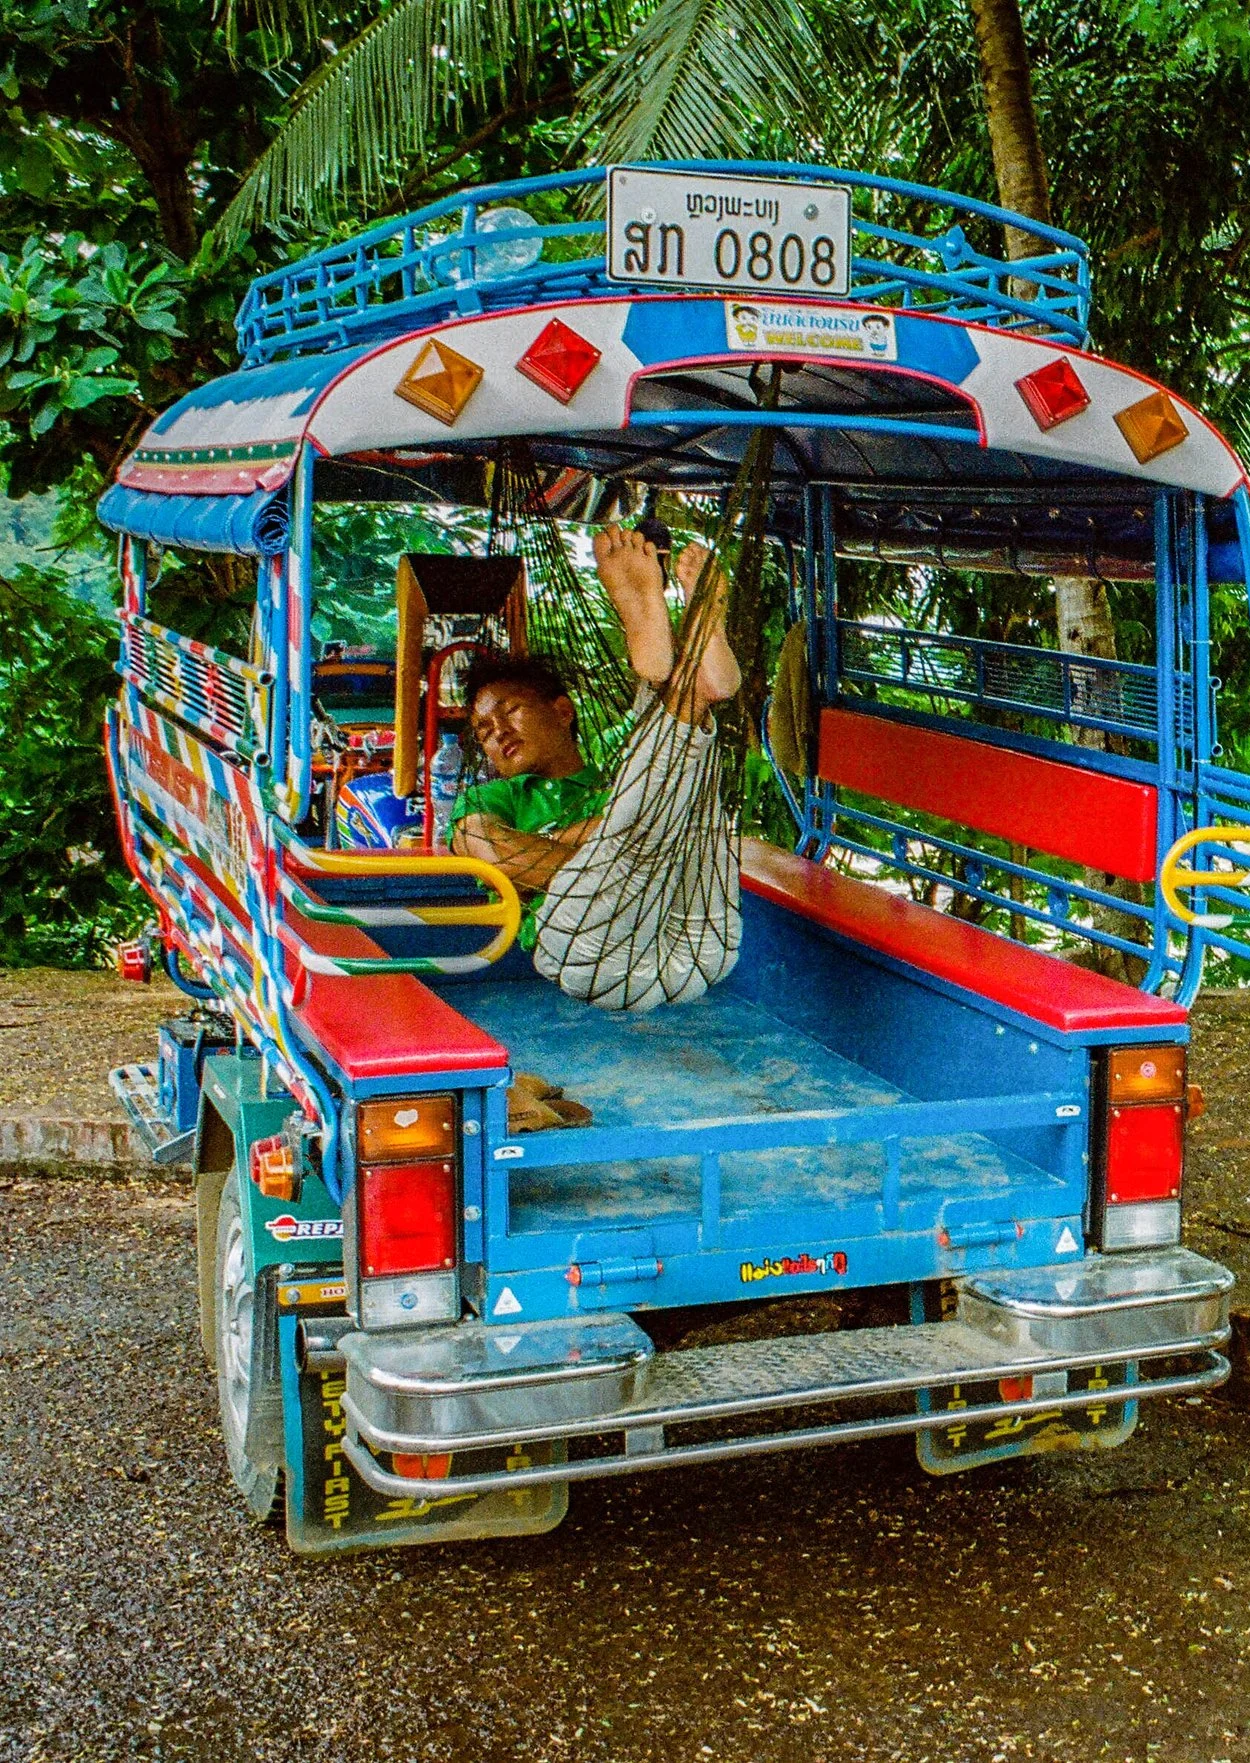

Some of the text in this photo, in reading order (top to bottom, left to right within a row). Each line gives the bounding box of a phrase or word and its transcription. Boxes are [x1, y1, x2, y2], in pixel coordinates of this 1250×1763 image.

[714, 228, 836, 286] 0808
[766, 331, 863, 351] WELCOME
[321, 1371, 350, 1529] ETY FIRST
